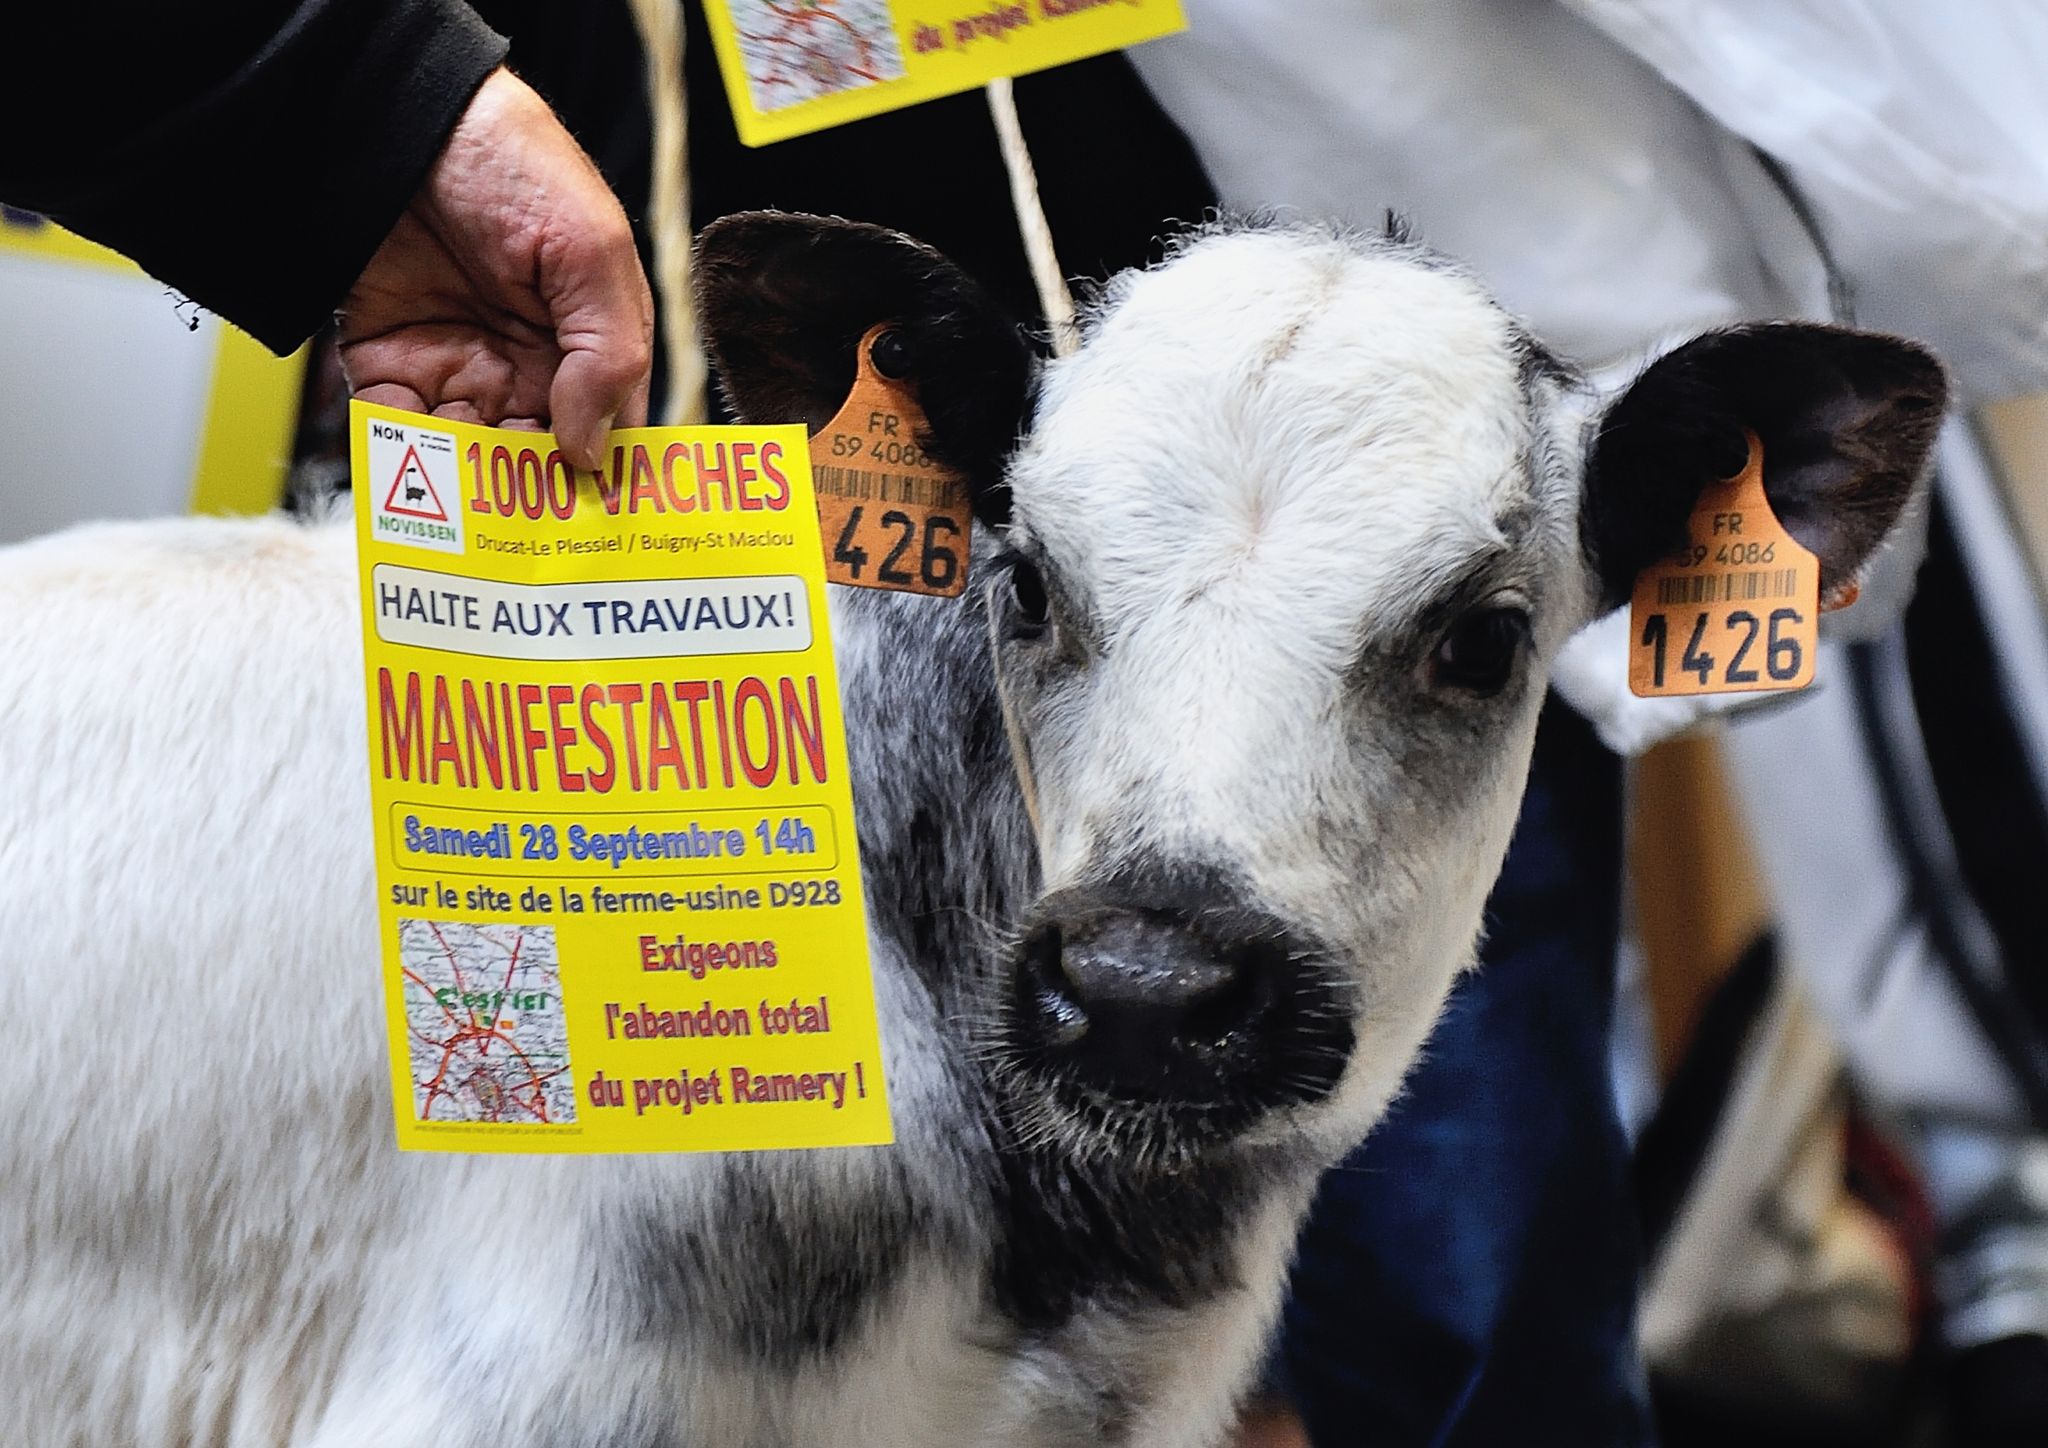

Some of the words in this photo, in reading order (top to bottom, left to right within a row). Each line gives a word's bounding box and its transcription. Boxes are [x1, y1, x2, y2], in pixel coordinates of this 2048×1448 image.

[373, 424, 405, 442] NON
[868, 411, 900, 437] FR
[832, 434, 863, 458] 59
[870, 440, 932, 469] 4086
[467, 441, 577, 520] 1000
[592, 442, 791, 516] VACHES
[378, 515, 457, 542] NOVISSEN
[476, 533, 551, 556] Drucat-Le
[556, 534, 623, 555] Plessiel
[627, 532, 637, 554] /
[641, 531, 725, 553] Buigny-St
[729, 530, 794, 548] Maclou
[1712, 512, 1744, 537] FR
[832, 505, 961, 590] 426
[1715, 541, 1776, 567] 4086
[380, 582, 480, 631] HALTE
[492, 600, 574, 637] AUX
[582, 591, 795, 636] TRAVAUX!
[1641, 607, 1804, 689] 1426
[378, 667, 828, 794] MANIFESTATION
[404, 815, 512, 860] Samedi
[519, 823, 560, 861] 28
[567, 822, 746, 869] Septembre
[754, 817, 816, 856] 14h
[391, 884, 429, 908] sur
[435, 880, 460, 910] le
[466, 884, 513, 912] site
[519, 885, 553, 914] de
[559, 885, 585, 914] la
[592, 883, 761, 915] ferme-usine
[768, 879, 842, 909] D928
[638, 934, 779, 980] Exigeons
[604, 1001, 752, 1040] l'abandon
[758, 996, 832, 1036] total
[587, 1070, 626, 1108] du
[632, 1068, 724, 1117] projet
[729, 1066, 848, 1110] Ramery
[854, 1061, 867, 1099] !
